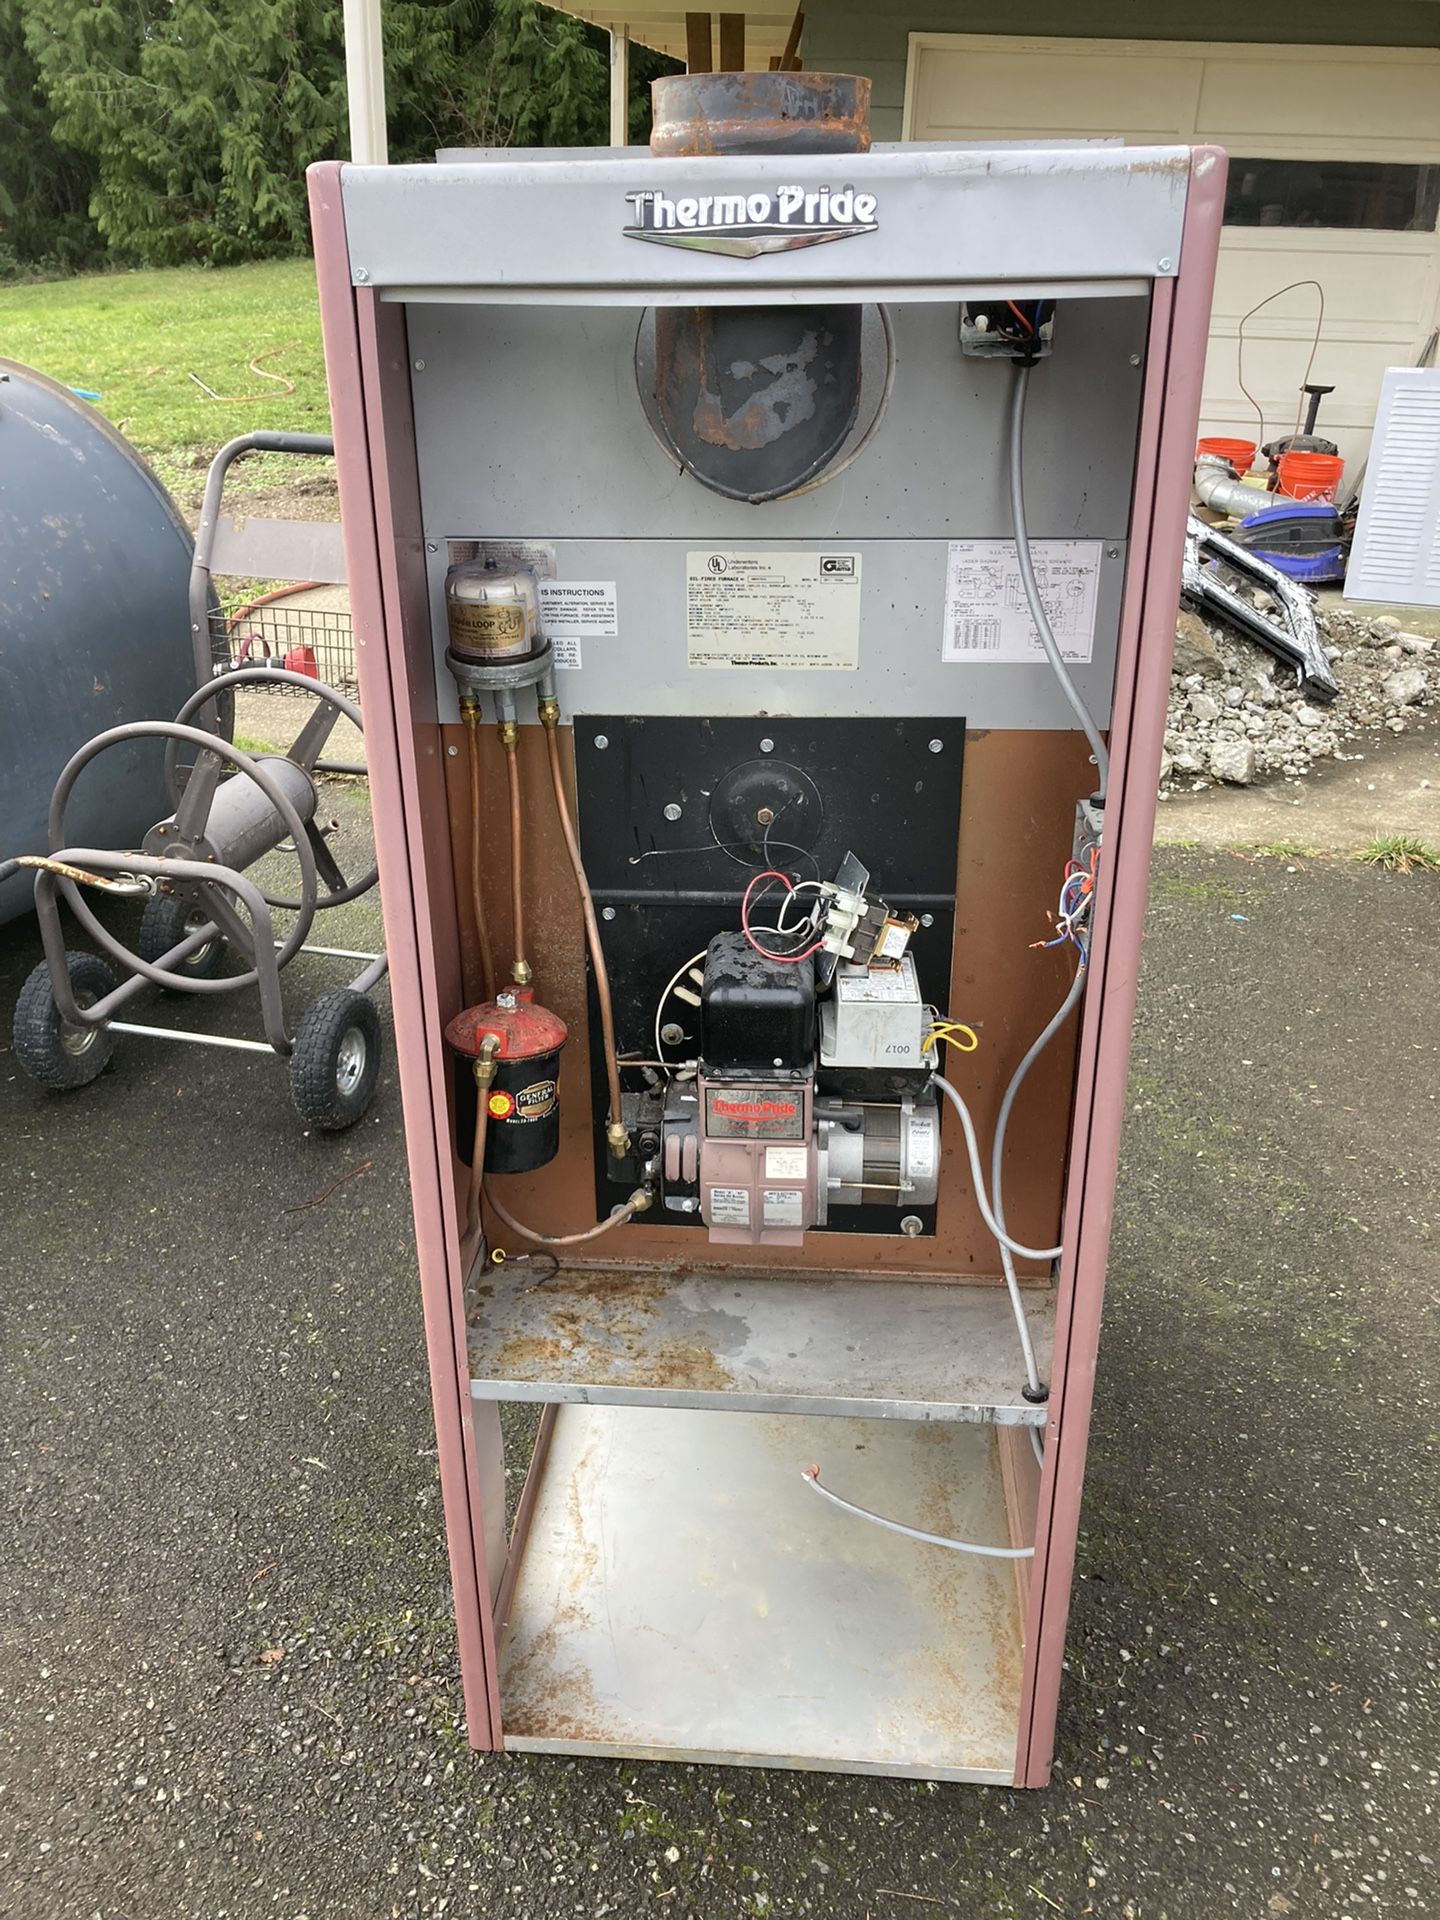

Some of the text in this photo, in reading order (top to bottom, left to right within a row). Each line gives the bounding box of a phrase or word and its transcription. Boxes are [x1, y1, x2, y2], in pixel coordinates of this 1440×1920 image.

[625, 184, 878, 228] Thermo Pride
[472, 620, 496, 629] LOOP
[885, 1045, 910, 1054] 0017
[520, 1086, 553, 1102] GENERAL
[712, 1099, 797, 1113] Thermo Pride
